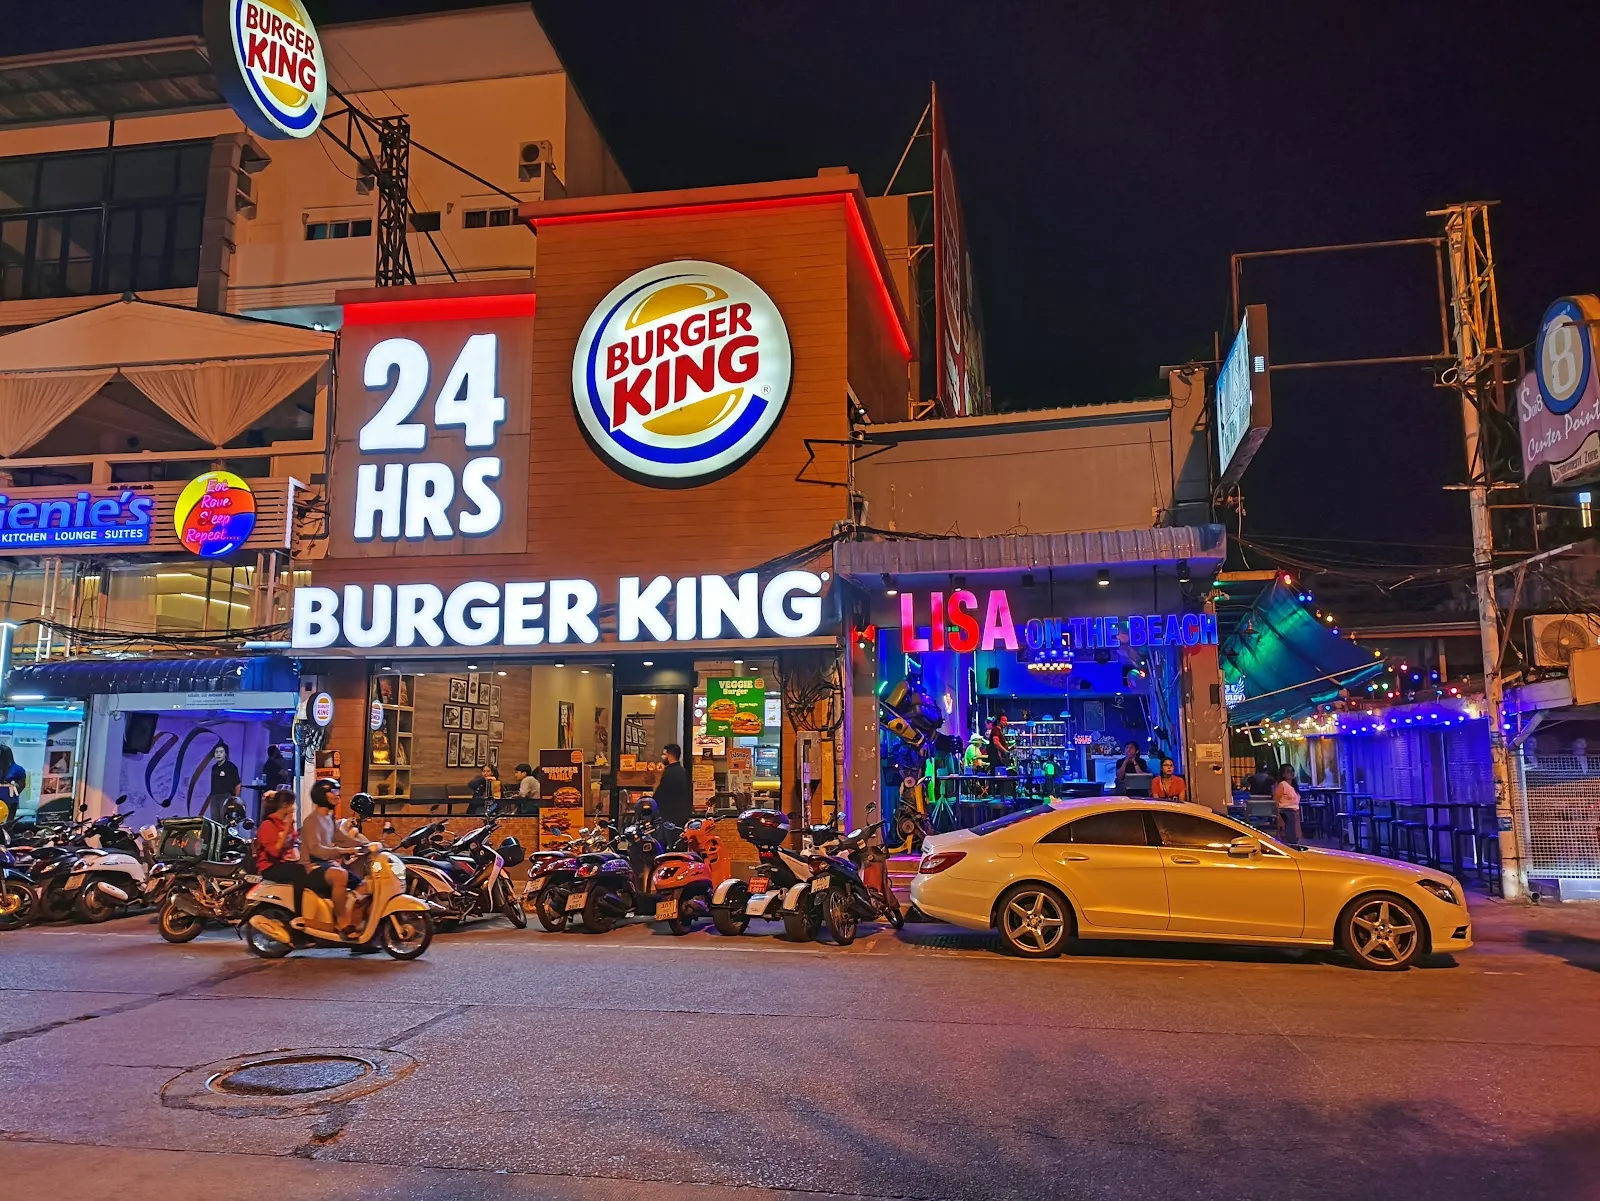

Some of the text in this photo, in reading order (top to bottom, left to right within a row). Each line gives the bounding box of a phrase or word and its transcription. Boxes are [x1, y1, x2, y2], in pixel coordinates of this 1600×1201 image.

[246, 3, 315, 60] BURGER
[247, 32, 317, 93] KING
[606, 302, 753, 380] BURGER
[1549, 324, 1577, 395] 8
[357, 332, 506, 450] 24
[609, 334, 760, 433] KING
[1527, 399, 1600, 462] Center Point
[0, 491, 153, 530] enie's
[353, 456, 503, 540] HRS
[2, 529, 144, 543] KITCHEN LOUNGE SUITES
[291, 570, 823, 650] BURGER KING
[900, 589, 1219, 653] LISA ON THE BEACH
